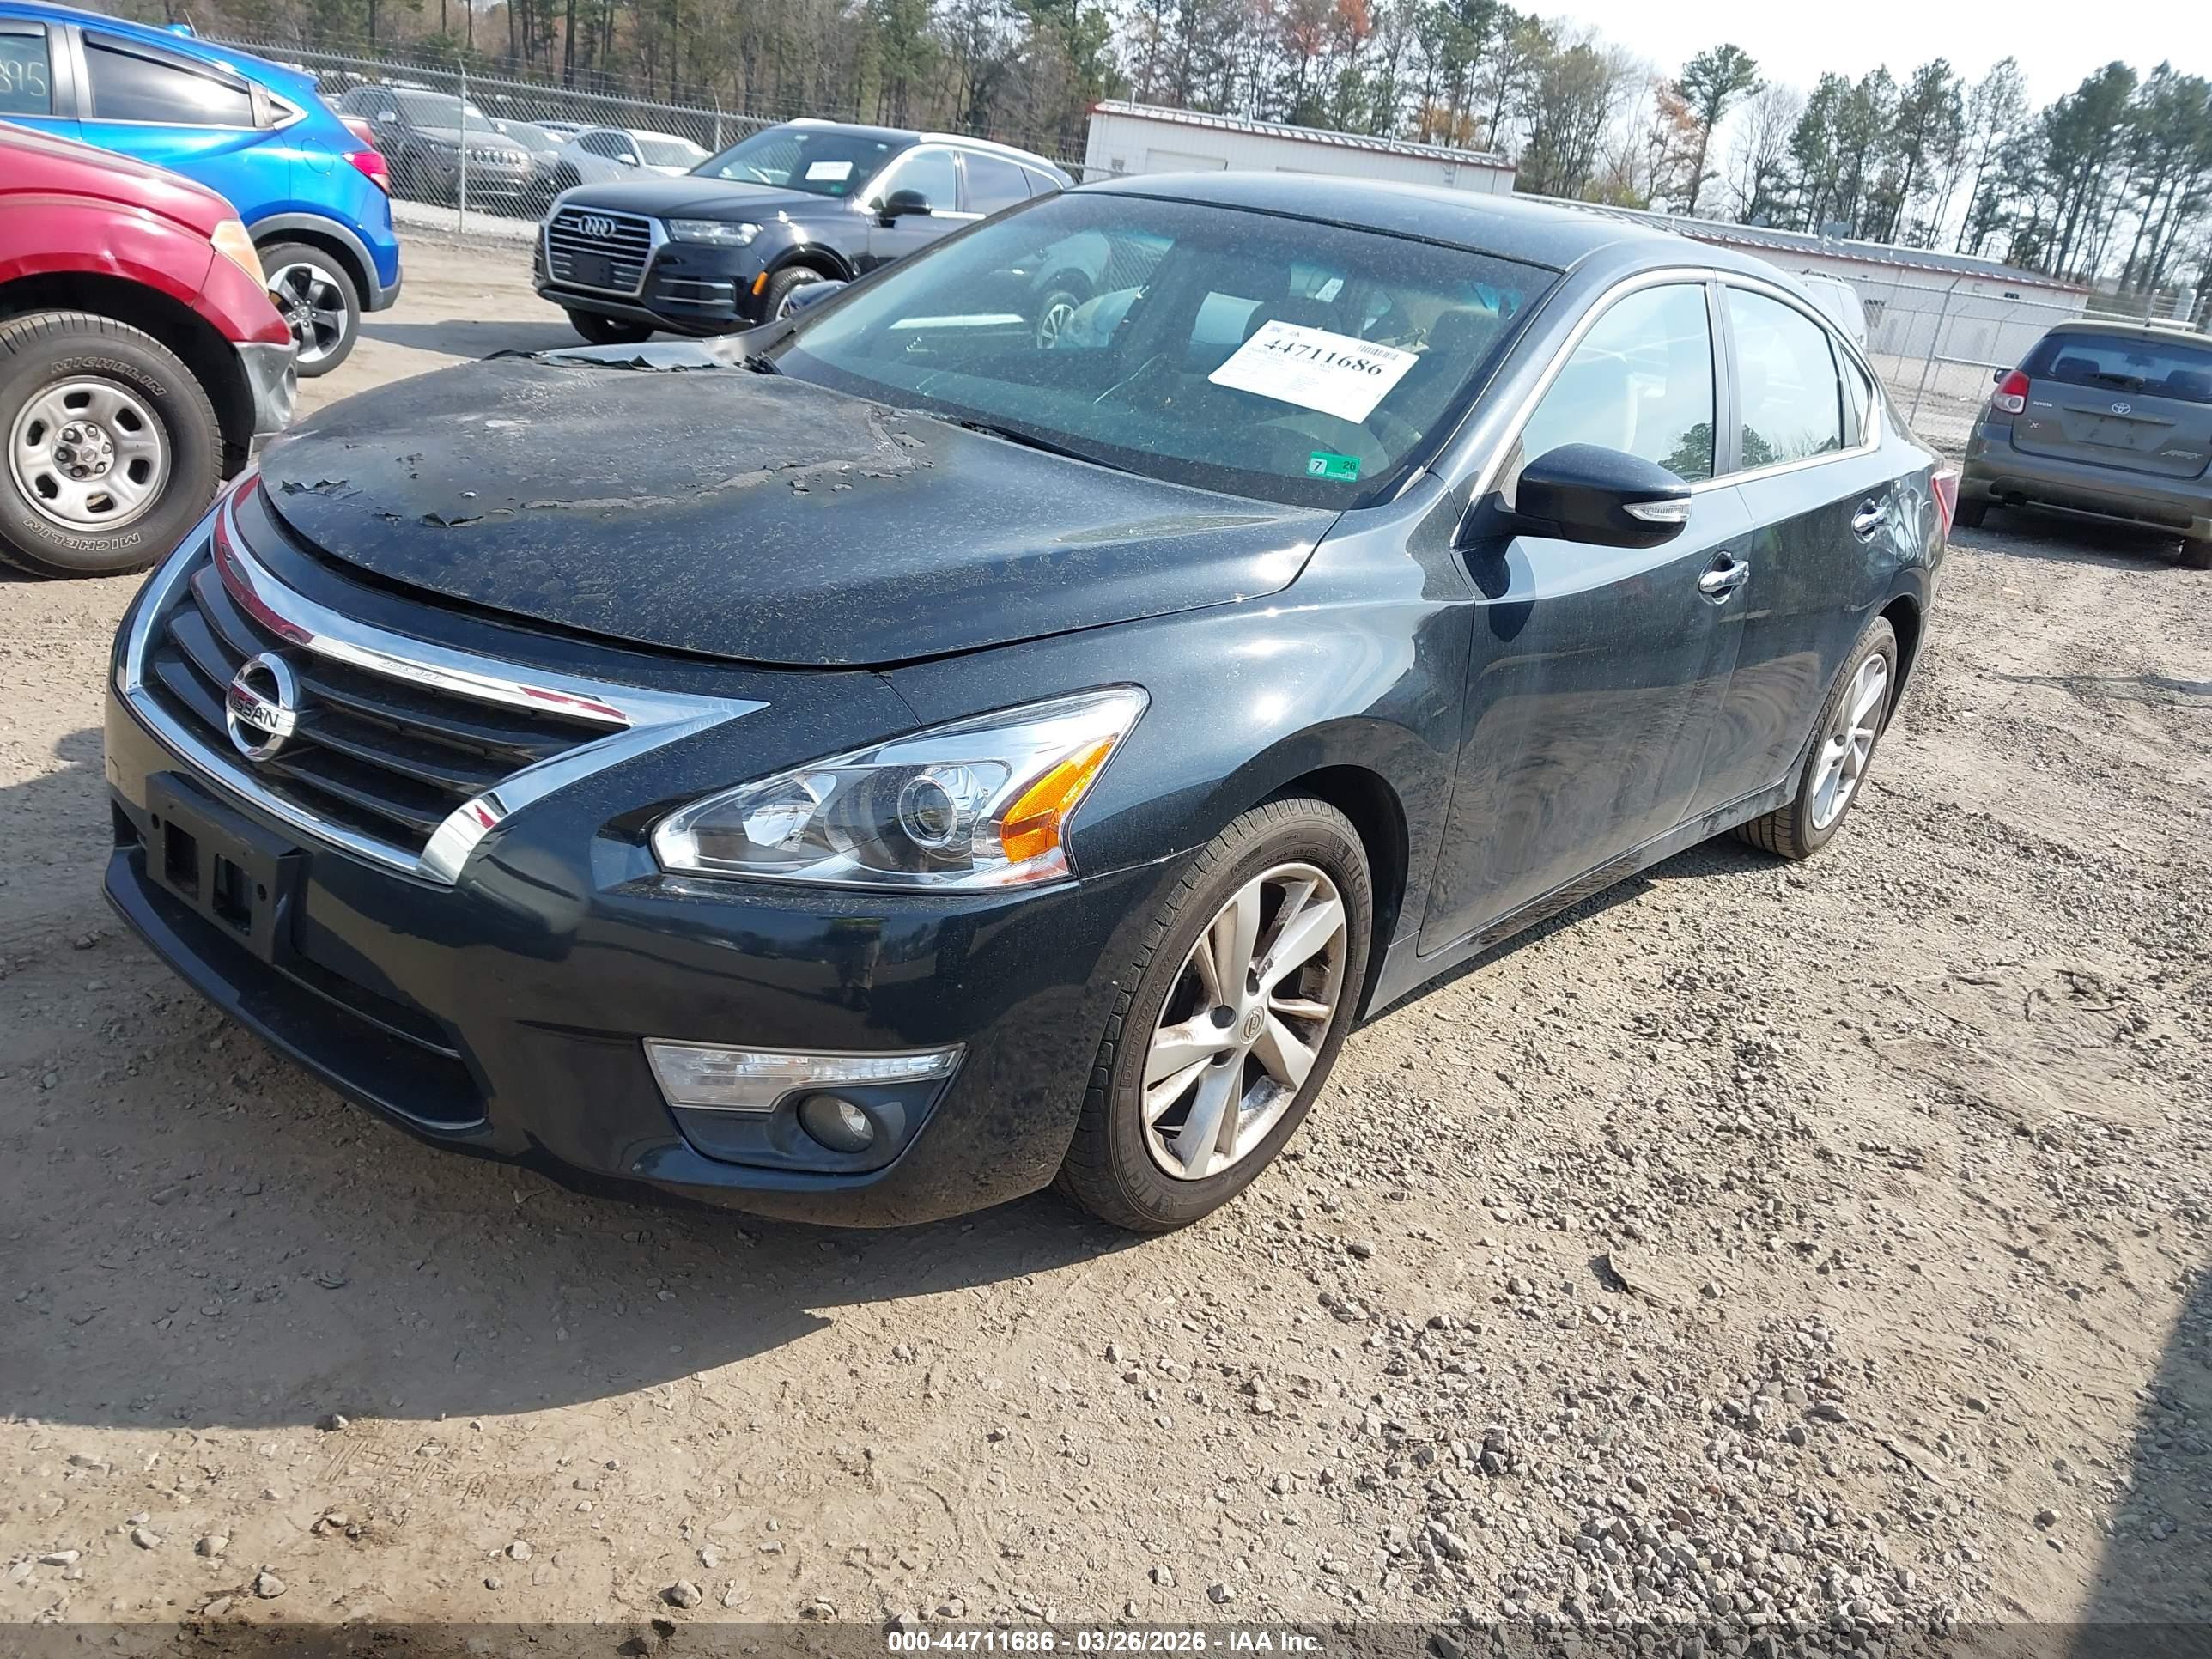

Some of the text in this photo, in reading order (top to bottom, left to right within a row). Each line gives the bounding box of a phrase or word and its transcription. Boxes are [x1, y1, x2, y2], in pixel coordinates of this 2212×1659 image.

[1263, 339, 1386, 375] 44711686
[51, 356, 167, 397] MICHELIN
[1315, 460, 1357, 471] 7 26
[23, 518, 141, 550] MICHELIN
[1342, 851, 1370, 962] MICHEL
